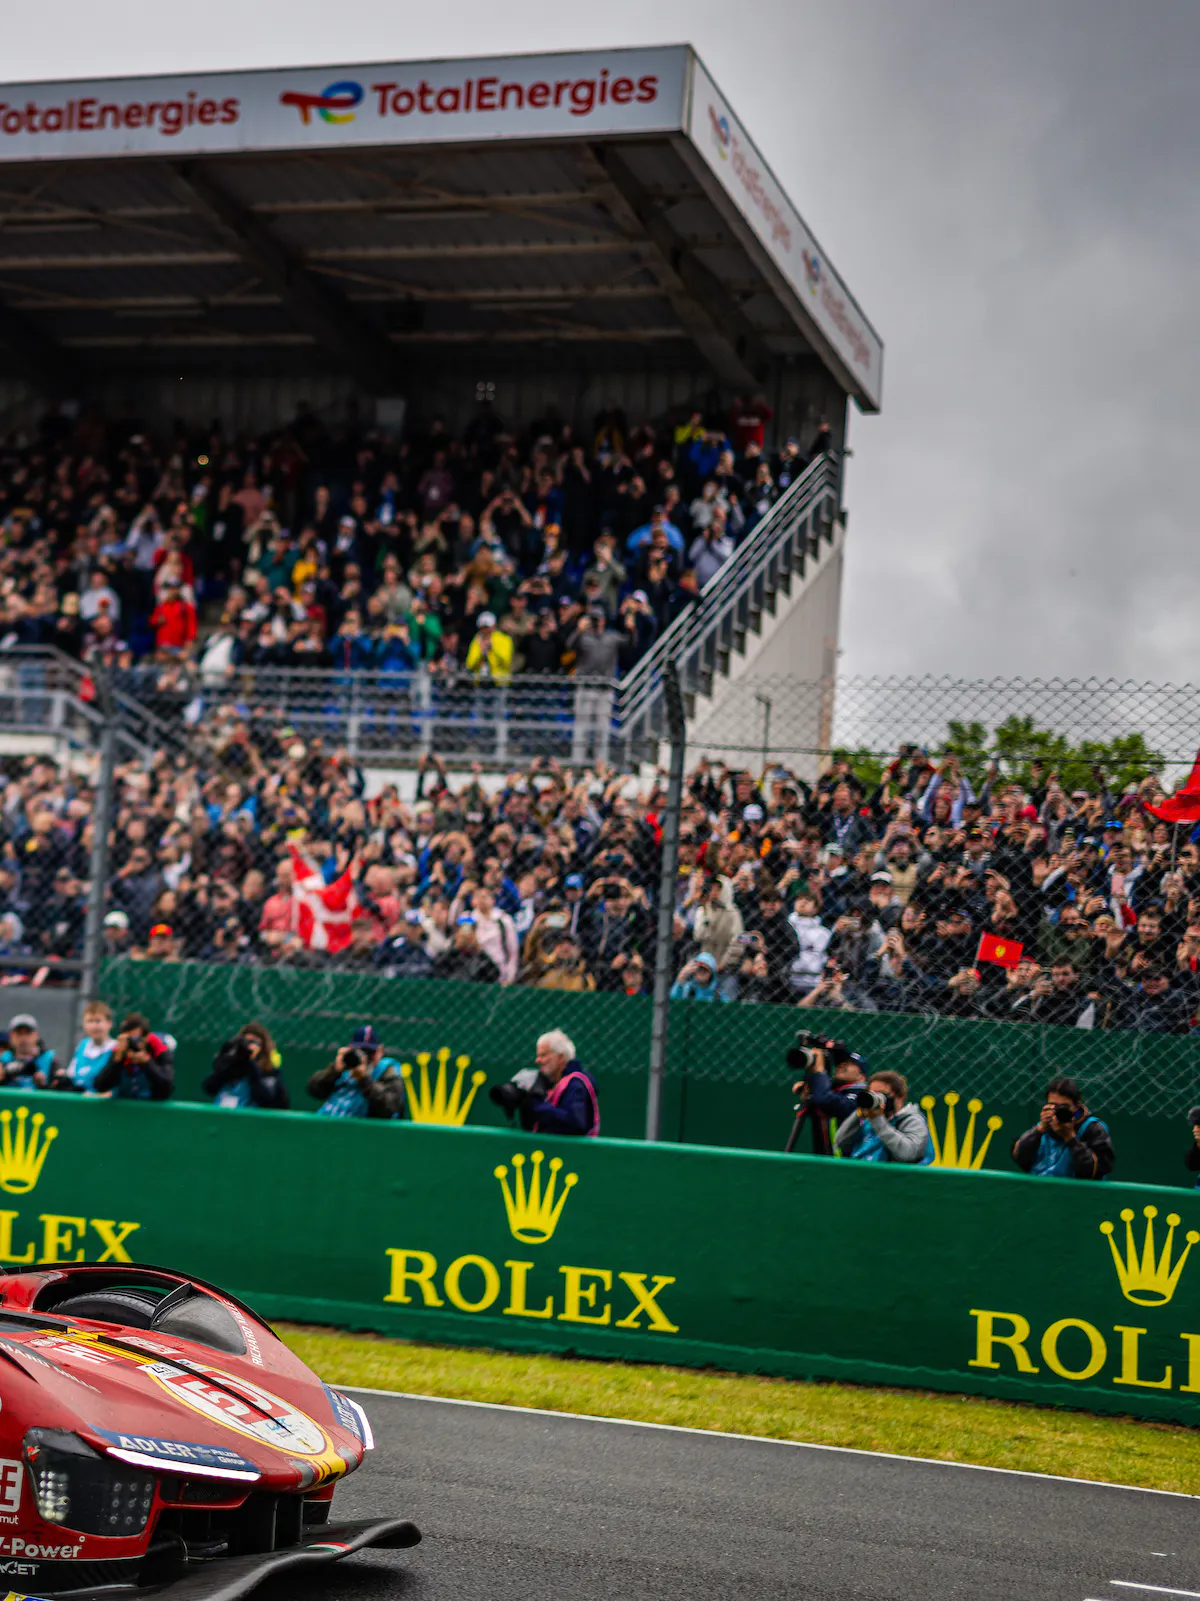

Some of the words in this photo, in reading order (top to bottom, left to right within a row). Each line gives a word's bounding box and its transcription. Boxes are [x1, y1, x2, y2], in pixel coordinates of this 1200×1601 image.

[372, 69, 658, 115] TotalEnergies
[384, 1247, 679, 1334] ROLEX
[117, 1435, 198, 1459] ADLER
[217, 1456, 246, 1466] GROUP
